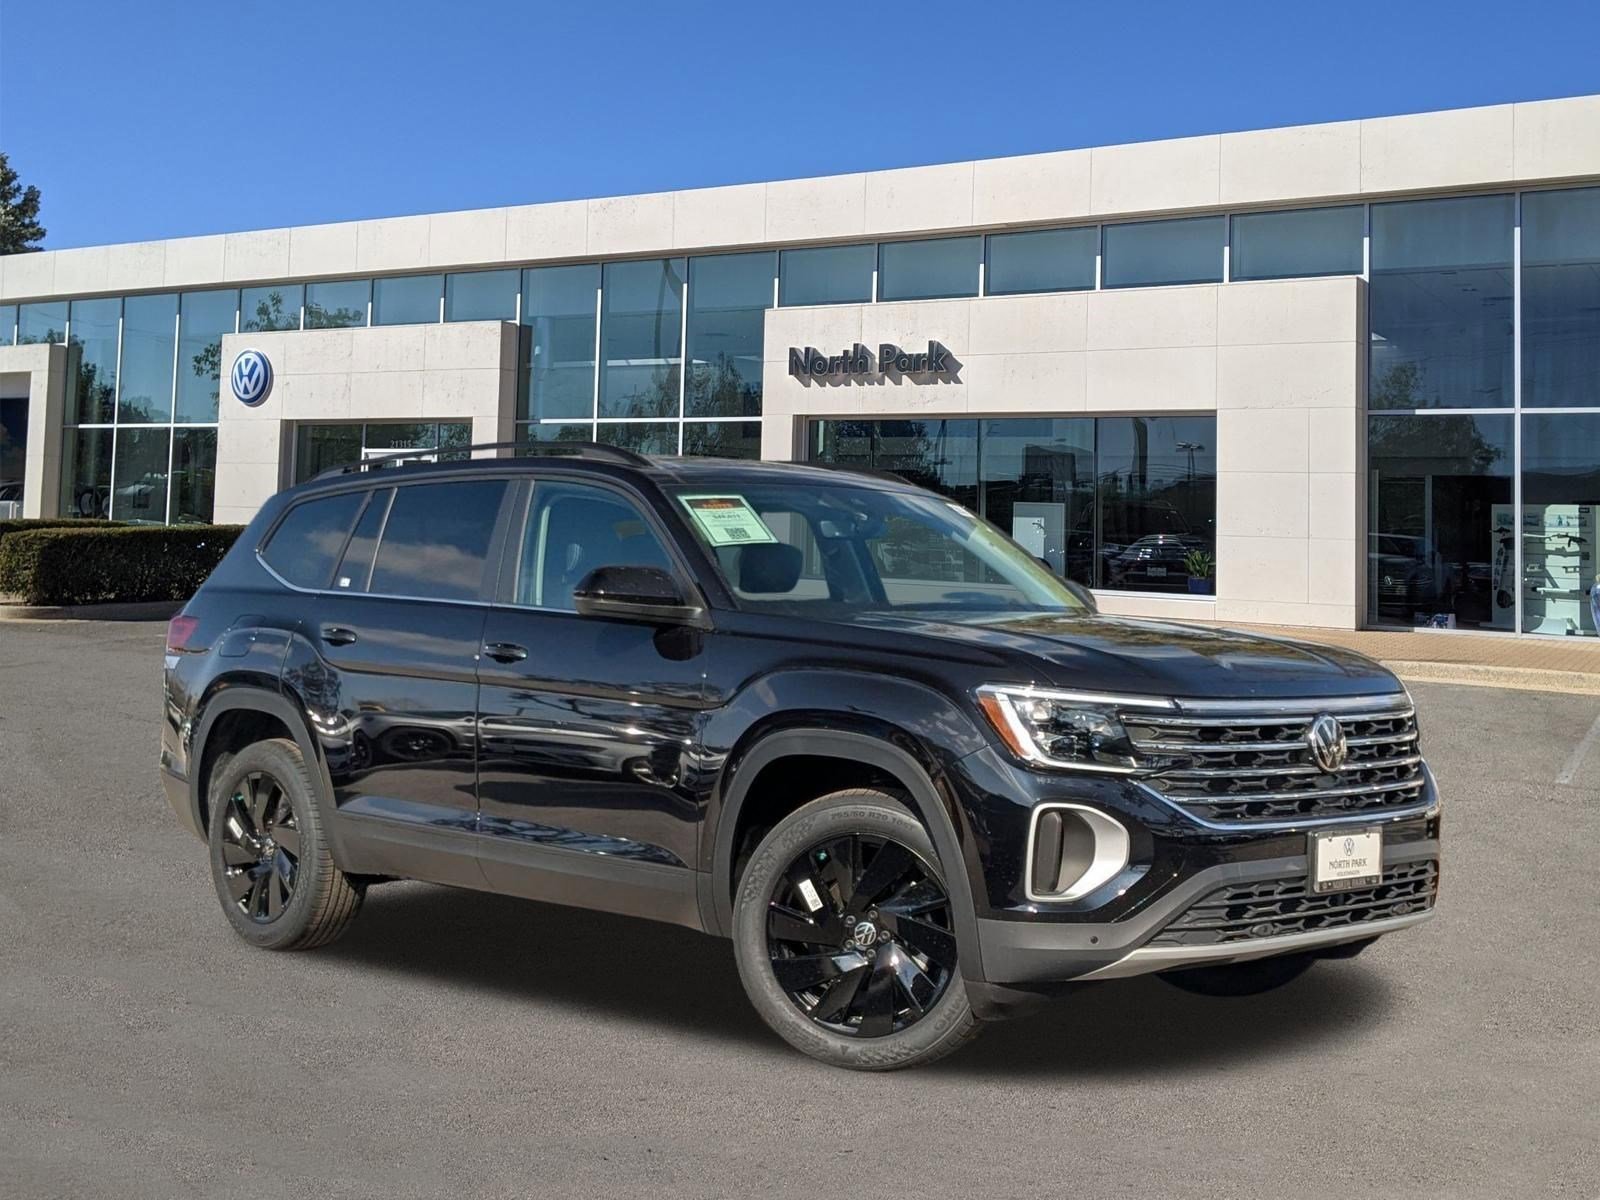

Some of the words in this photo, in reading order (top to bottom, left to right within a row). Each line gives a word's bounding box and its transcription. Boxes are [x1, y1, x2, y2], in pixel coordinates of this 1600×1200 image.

[788, 342, 871, 376] North
[878, 340, 947, 373] Park
[231, 351, 268, 402] VW
[390, 439, 412, 449] 21315
[1328, 859, 1351, 870] NORTH
[1351, 857, 1368, 868] PARK
